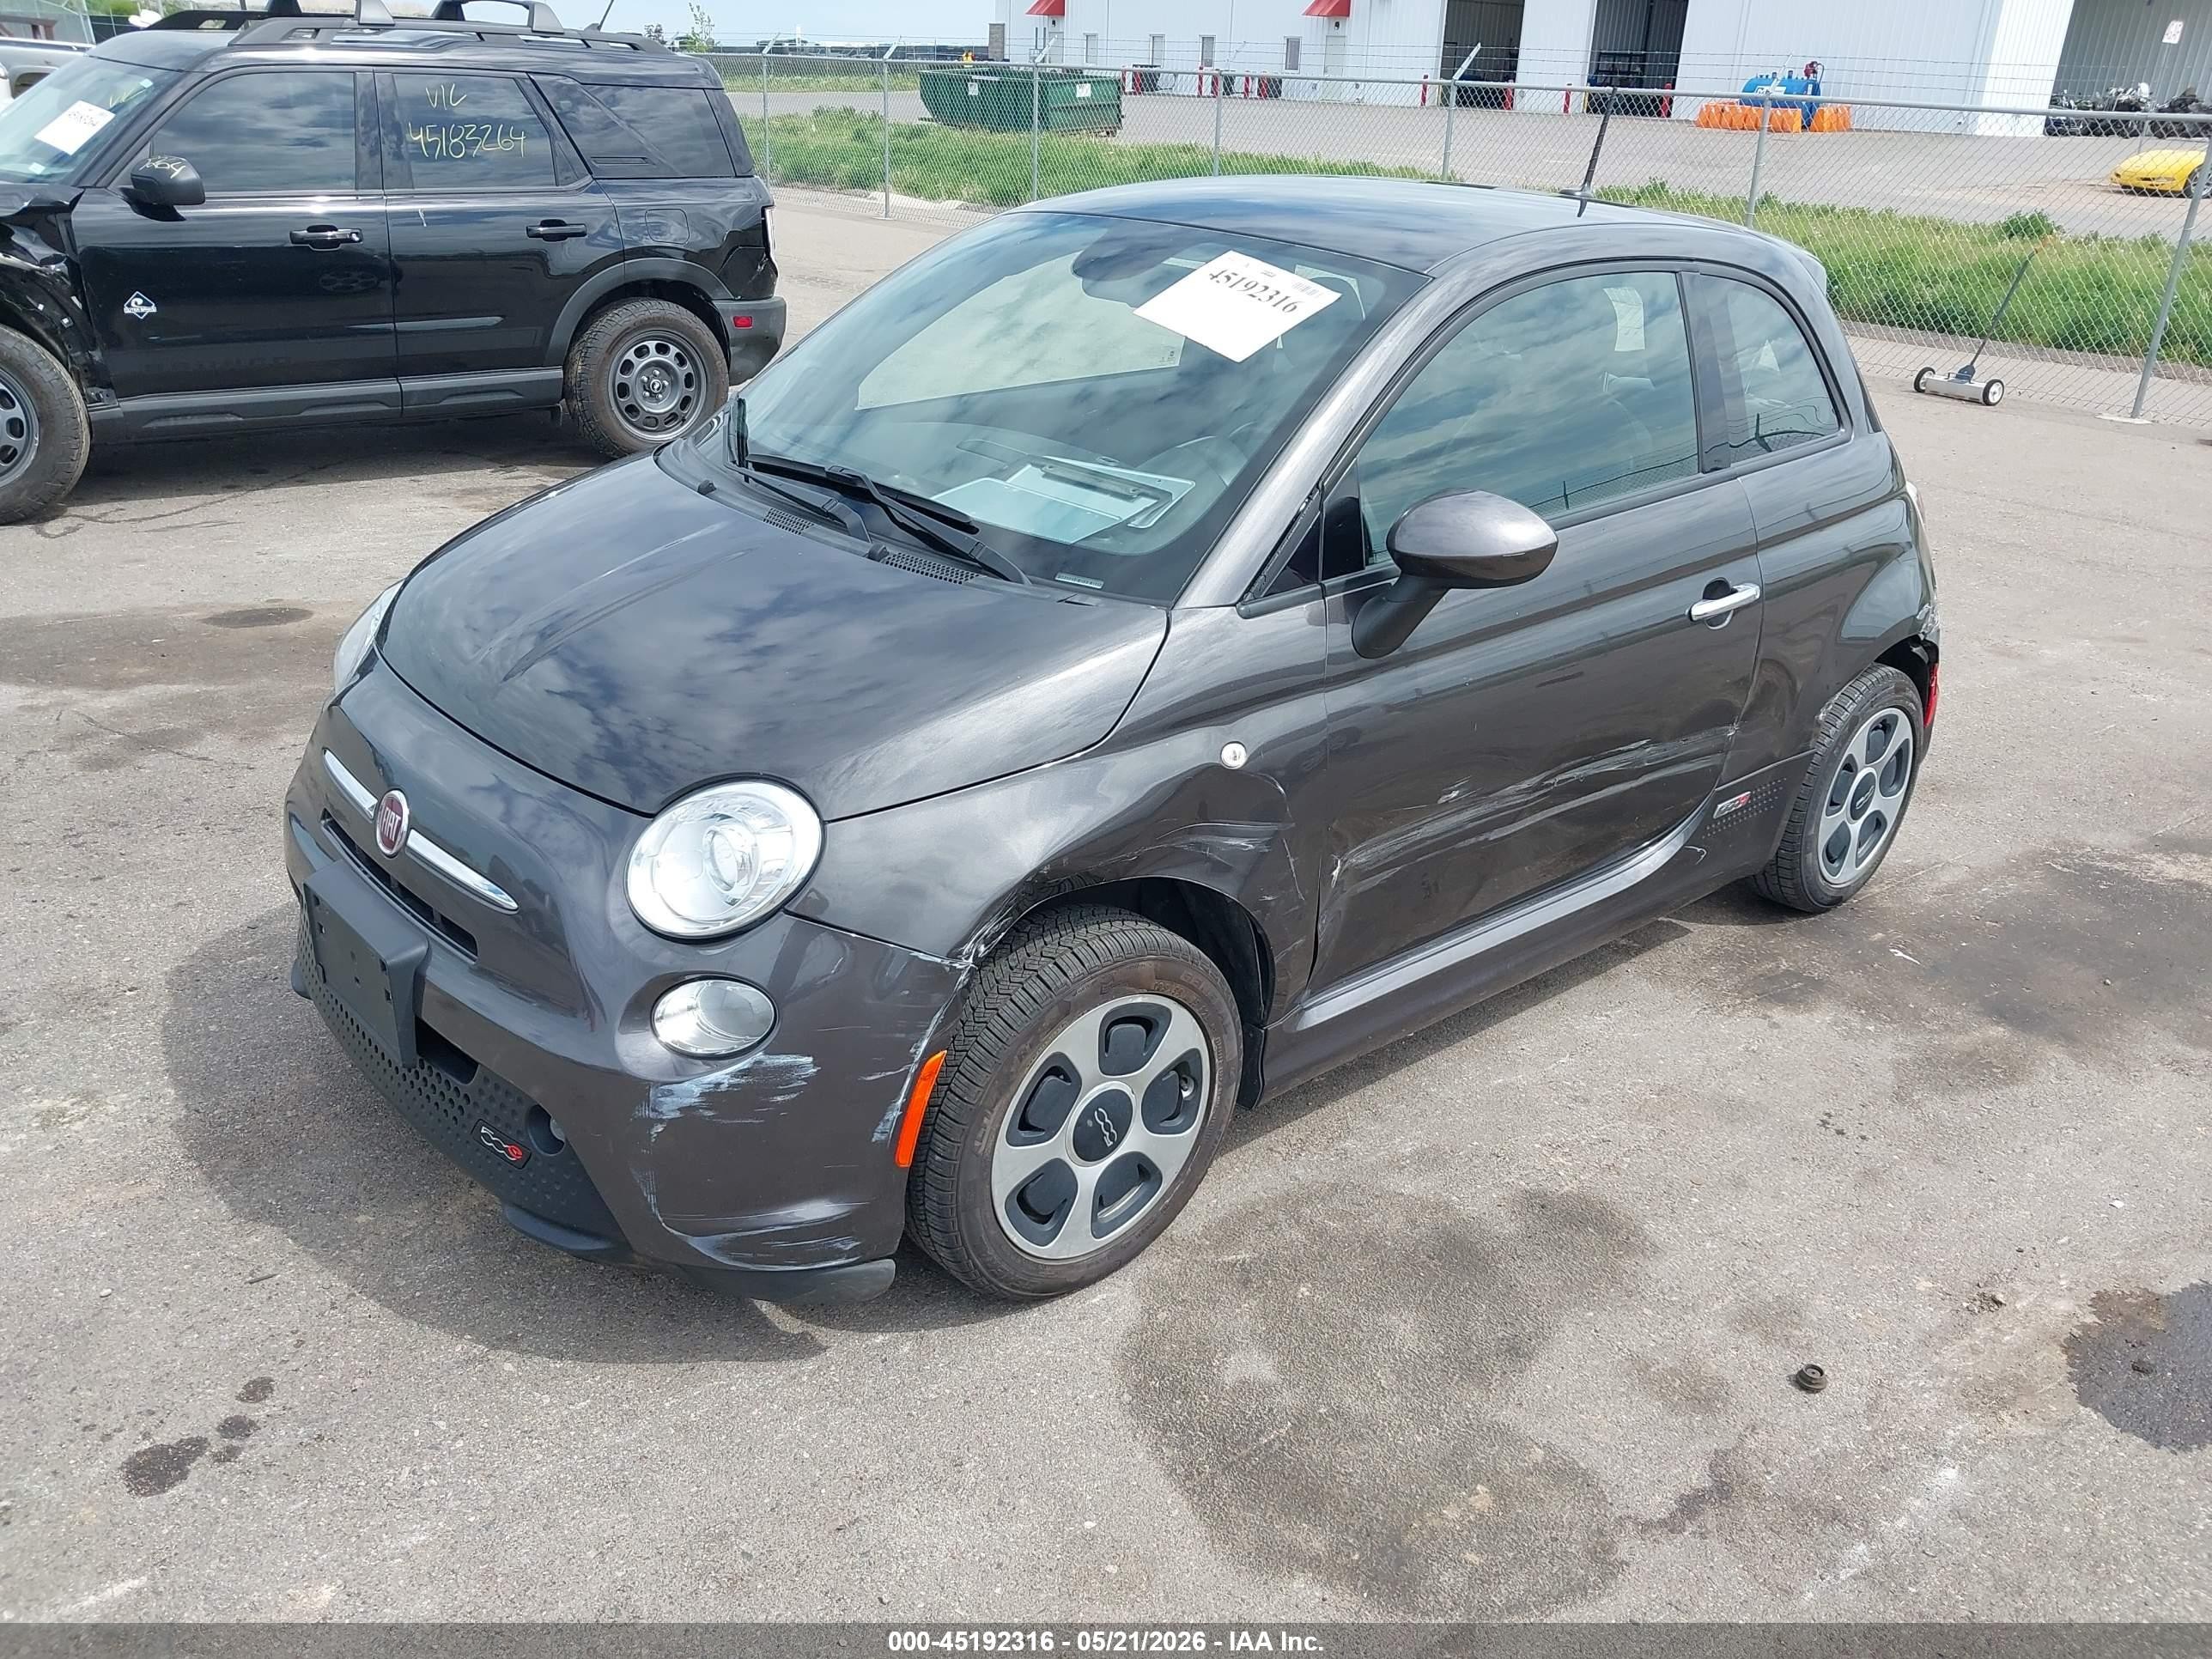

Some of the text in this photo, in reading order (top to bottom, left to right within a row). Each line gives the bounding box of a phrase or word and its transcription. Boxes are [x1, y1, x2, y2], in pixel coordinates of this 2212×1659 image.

[408, 121, 526, 160] 45183264
[1209, 270, 1303, 313] 45192316
[381, 805, 402, 842] FIAT
